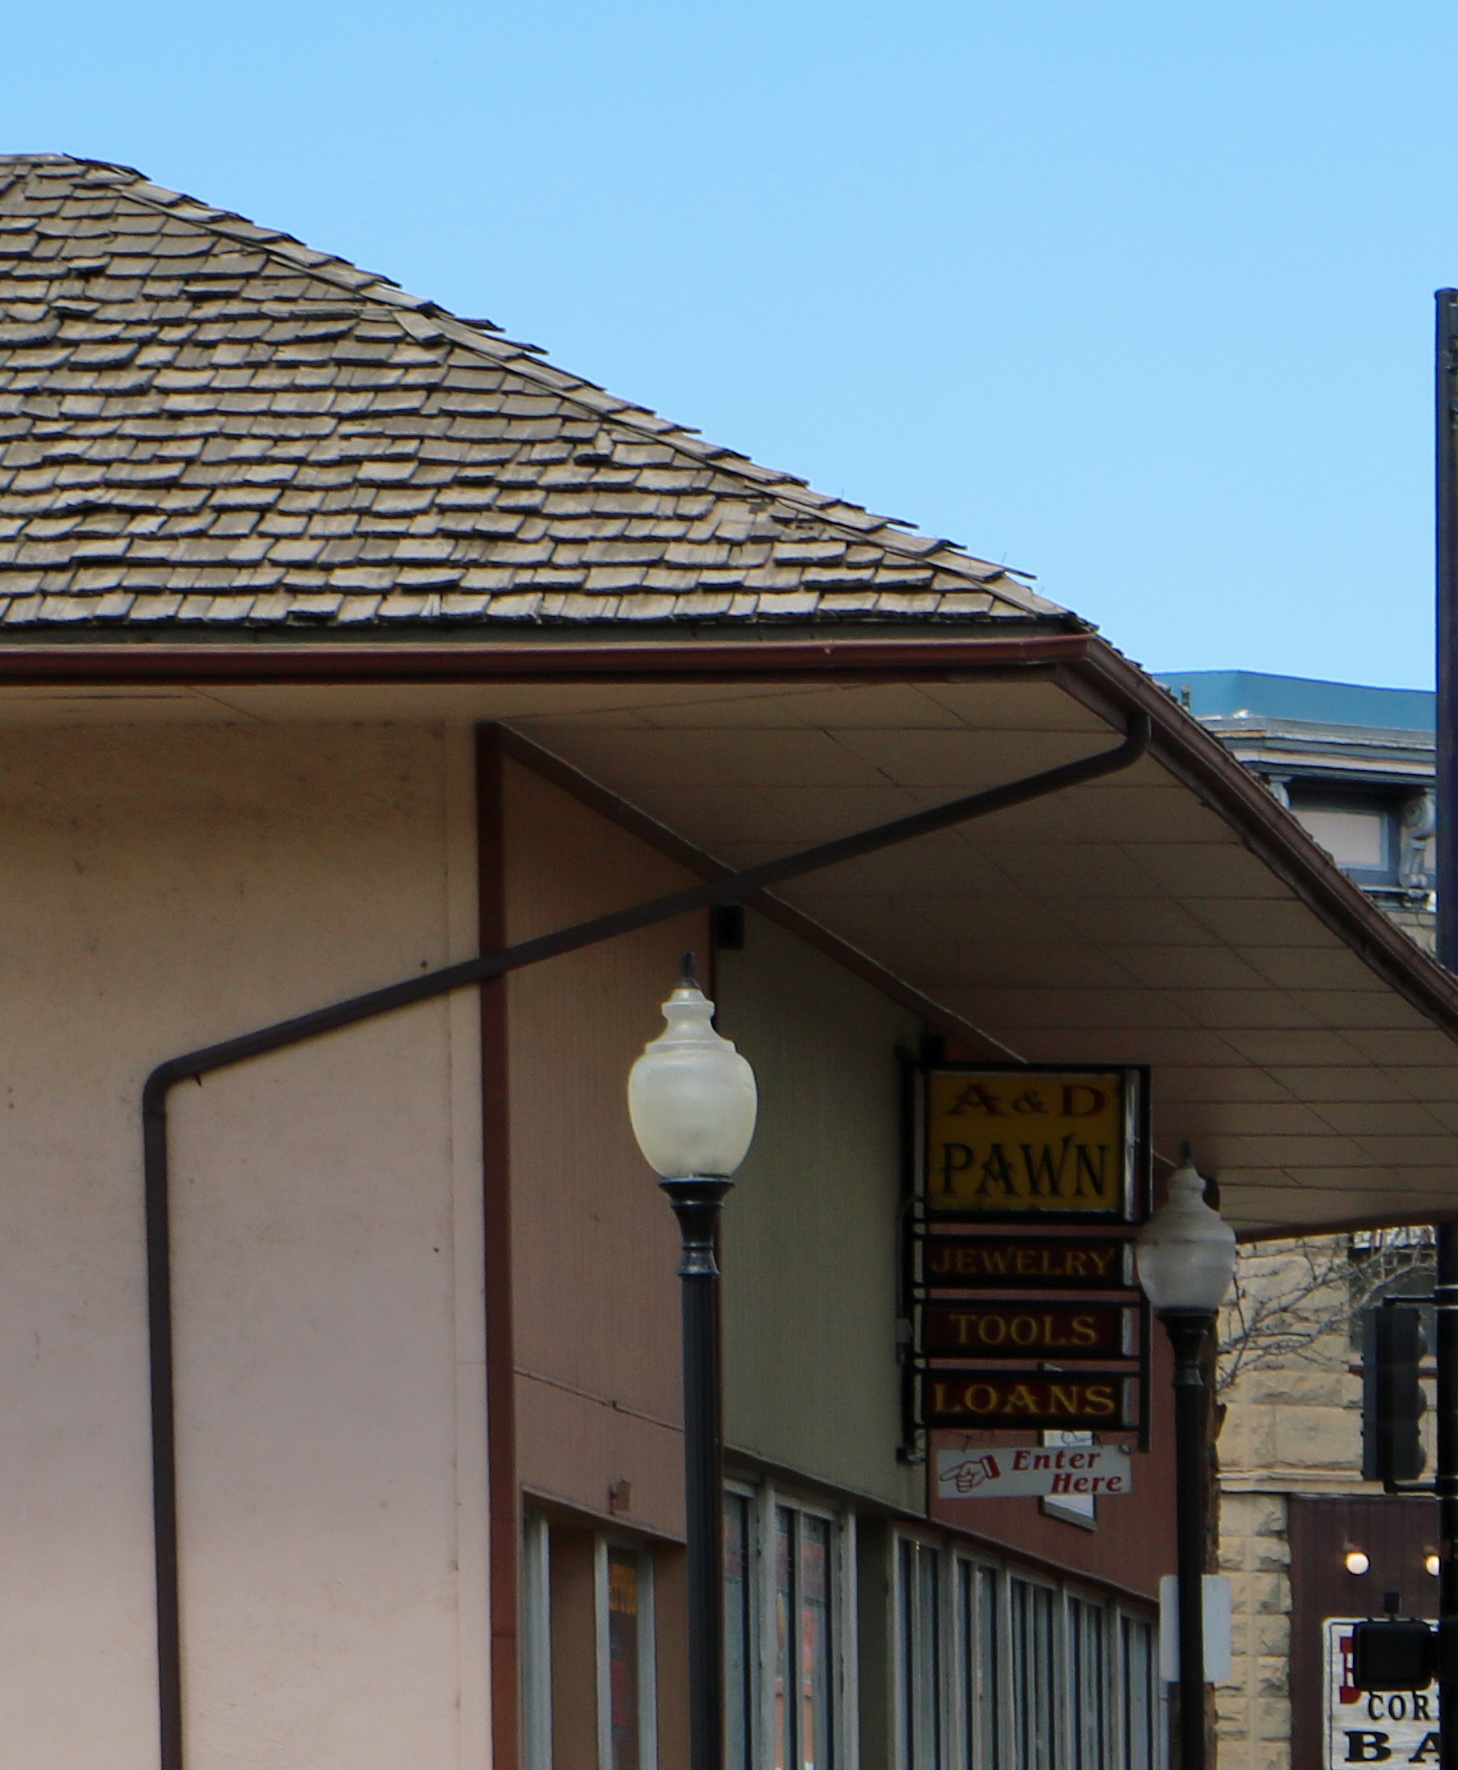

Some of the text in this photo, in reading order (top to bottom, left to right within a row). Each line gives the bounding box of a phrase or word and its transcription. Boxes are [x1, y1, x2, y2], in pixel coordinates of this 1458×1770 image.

[946, 1083, 1106, 1117] A & D
[941, 1132, 1109, 1198] PAWN
[932, 1248, 1114, 1276] JEWELRY
[950, 1314, 1098, 1346] TOOLS
[934, 1383, 1116, 1416] LOANS
[1011, 1450, 1101, 1472] Enter
[1051, 1473, 1122, 1494] Here
